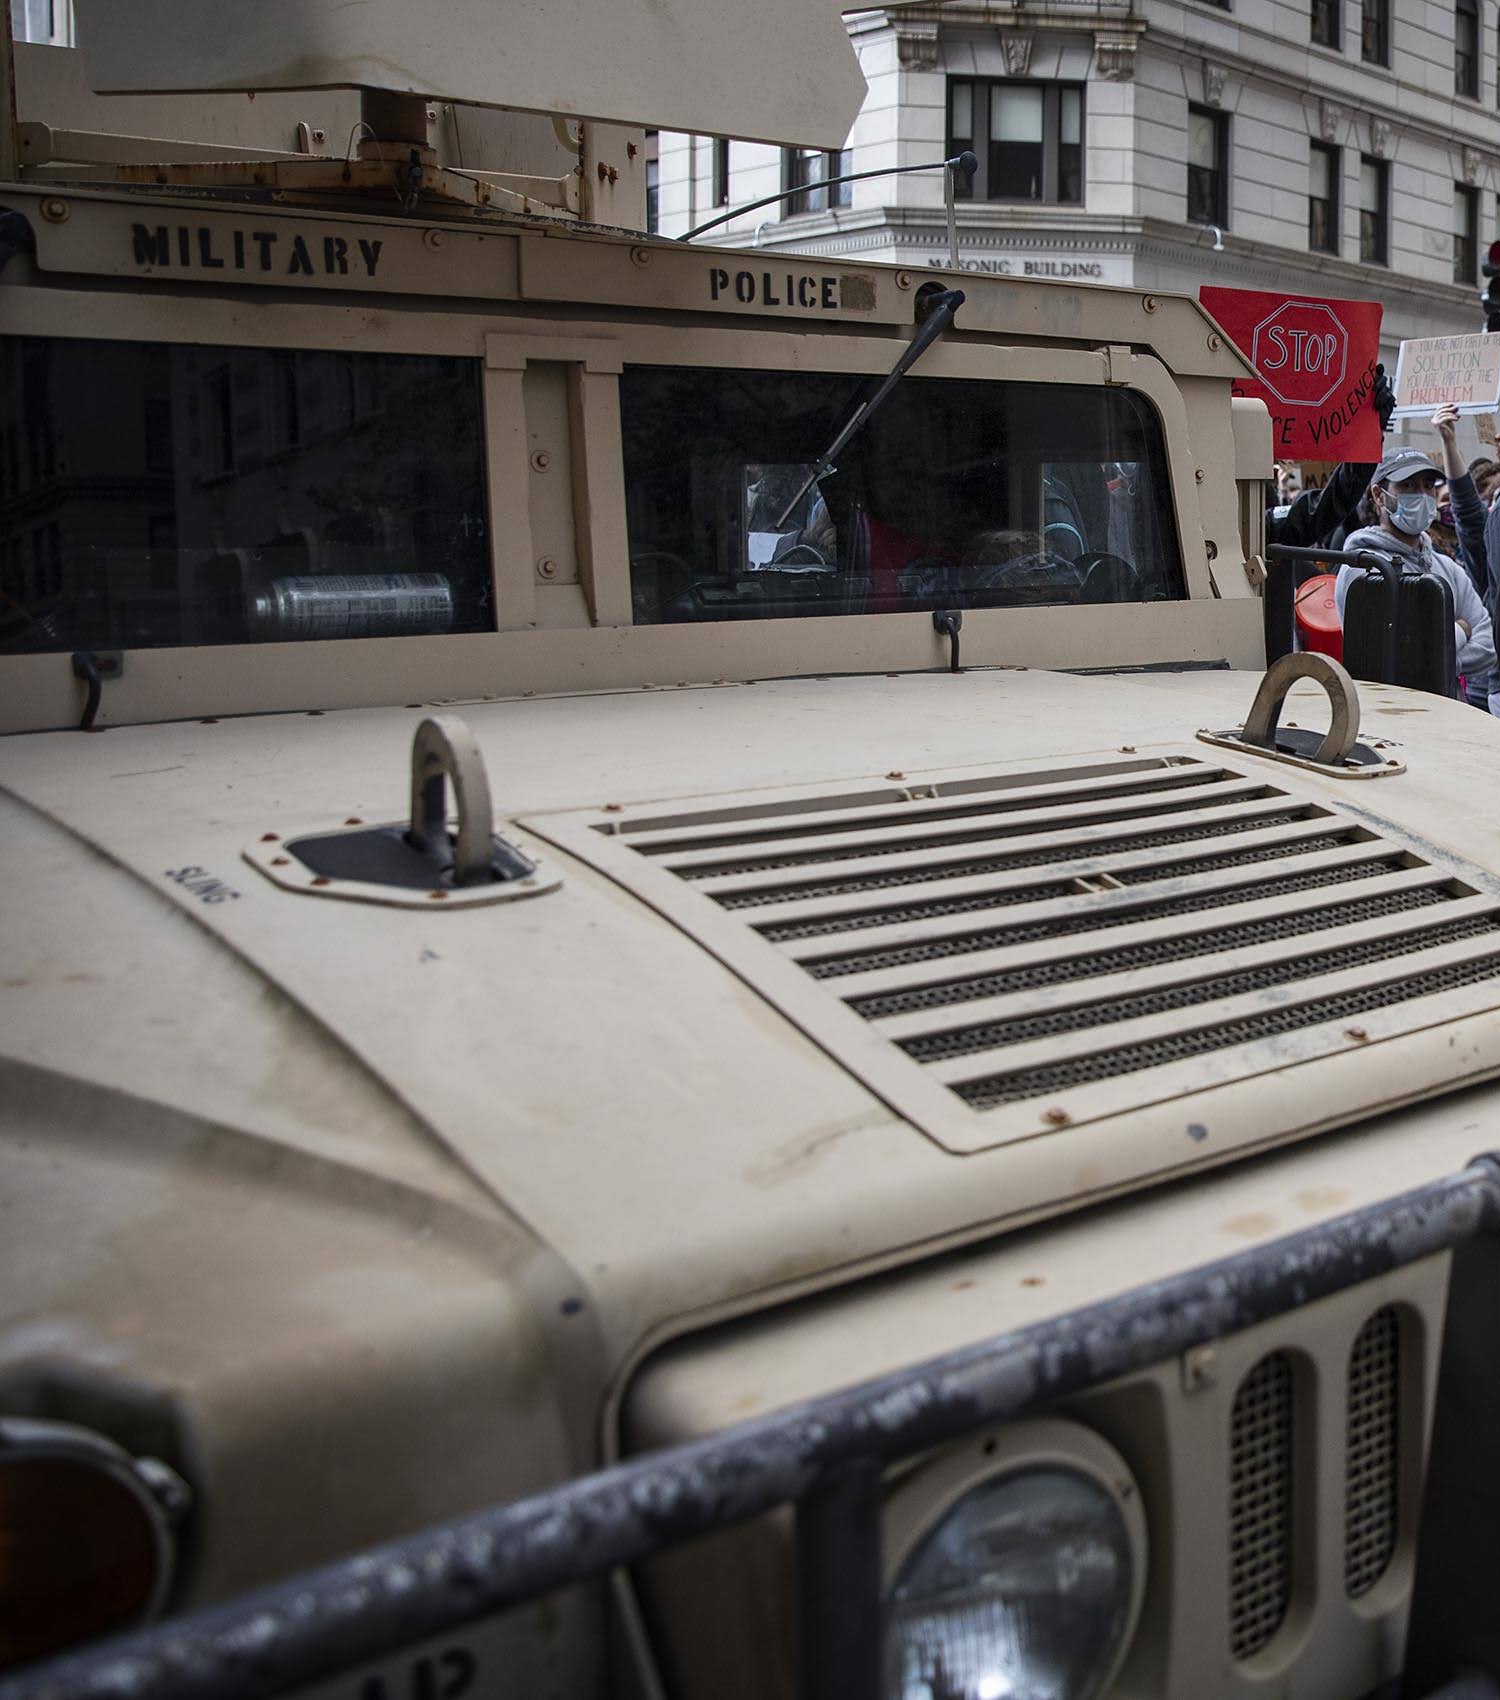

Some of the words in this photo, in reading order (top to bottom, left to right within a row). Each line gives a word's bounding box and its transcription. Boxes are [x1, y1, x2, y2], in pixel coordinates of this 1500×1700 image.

[131, 222, 383, 277] MILITARY
[1023, 260, 1103, 278] BUILDING
[709, 267, 838, 309] POLICE
[1263, 325, 1338, 376] STOP
[1464, 334, 1481, 348] PART
[1413, 352, 1480, 374] SOLUTION
[1407, 375, 1421, 389] YOU
[1422, 372, 1438, 387] ARE
[1442, 369, 1462, 386] PART
[1478, 368, 1494, 383] THE
[1307, 359, 1378, 444] VIOLENCE
[1410, 386, 1474, 404] PROBLEM
